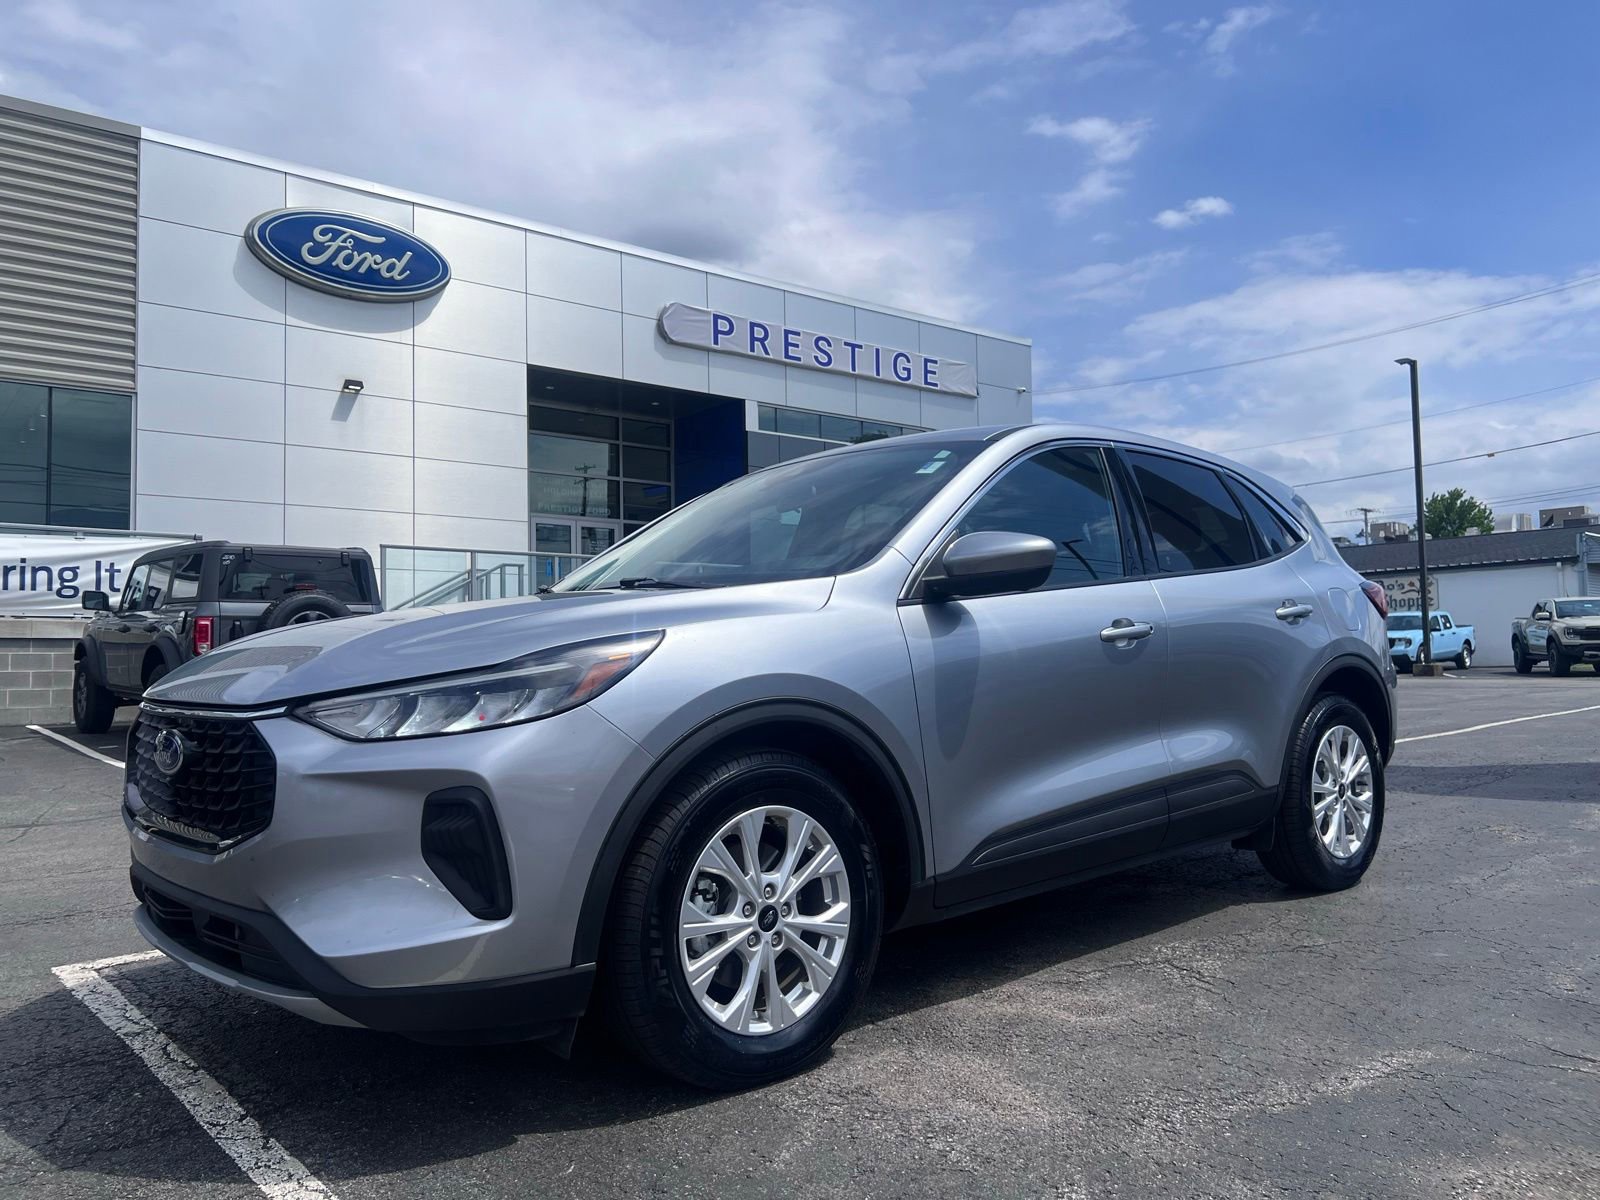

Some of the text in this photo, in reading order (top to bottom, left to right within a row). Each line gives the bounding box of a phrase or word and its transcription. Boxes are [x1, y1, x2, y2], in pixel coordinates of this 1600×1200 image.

[301, 224, 413, 281] Ford
[711, 312, 940, 389] PRESTIGE
[95, 560, 121, 593] It
